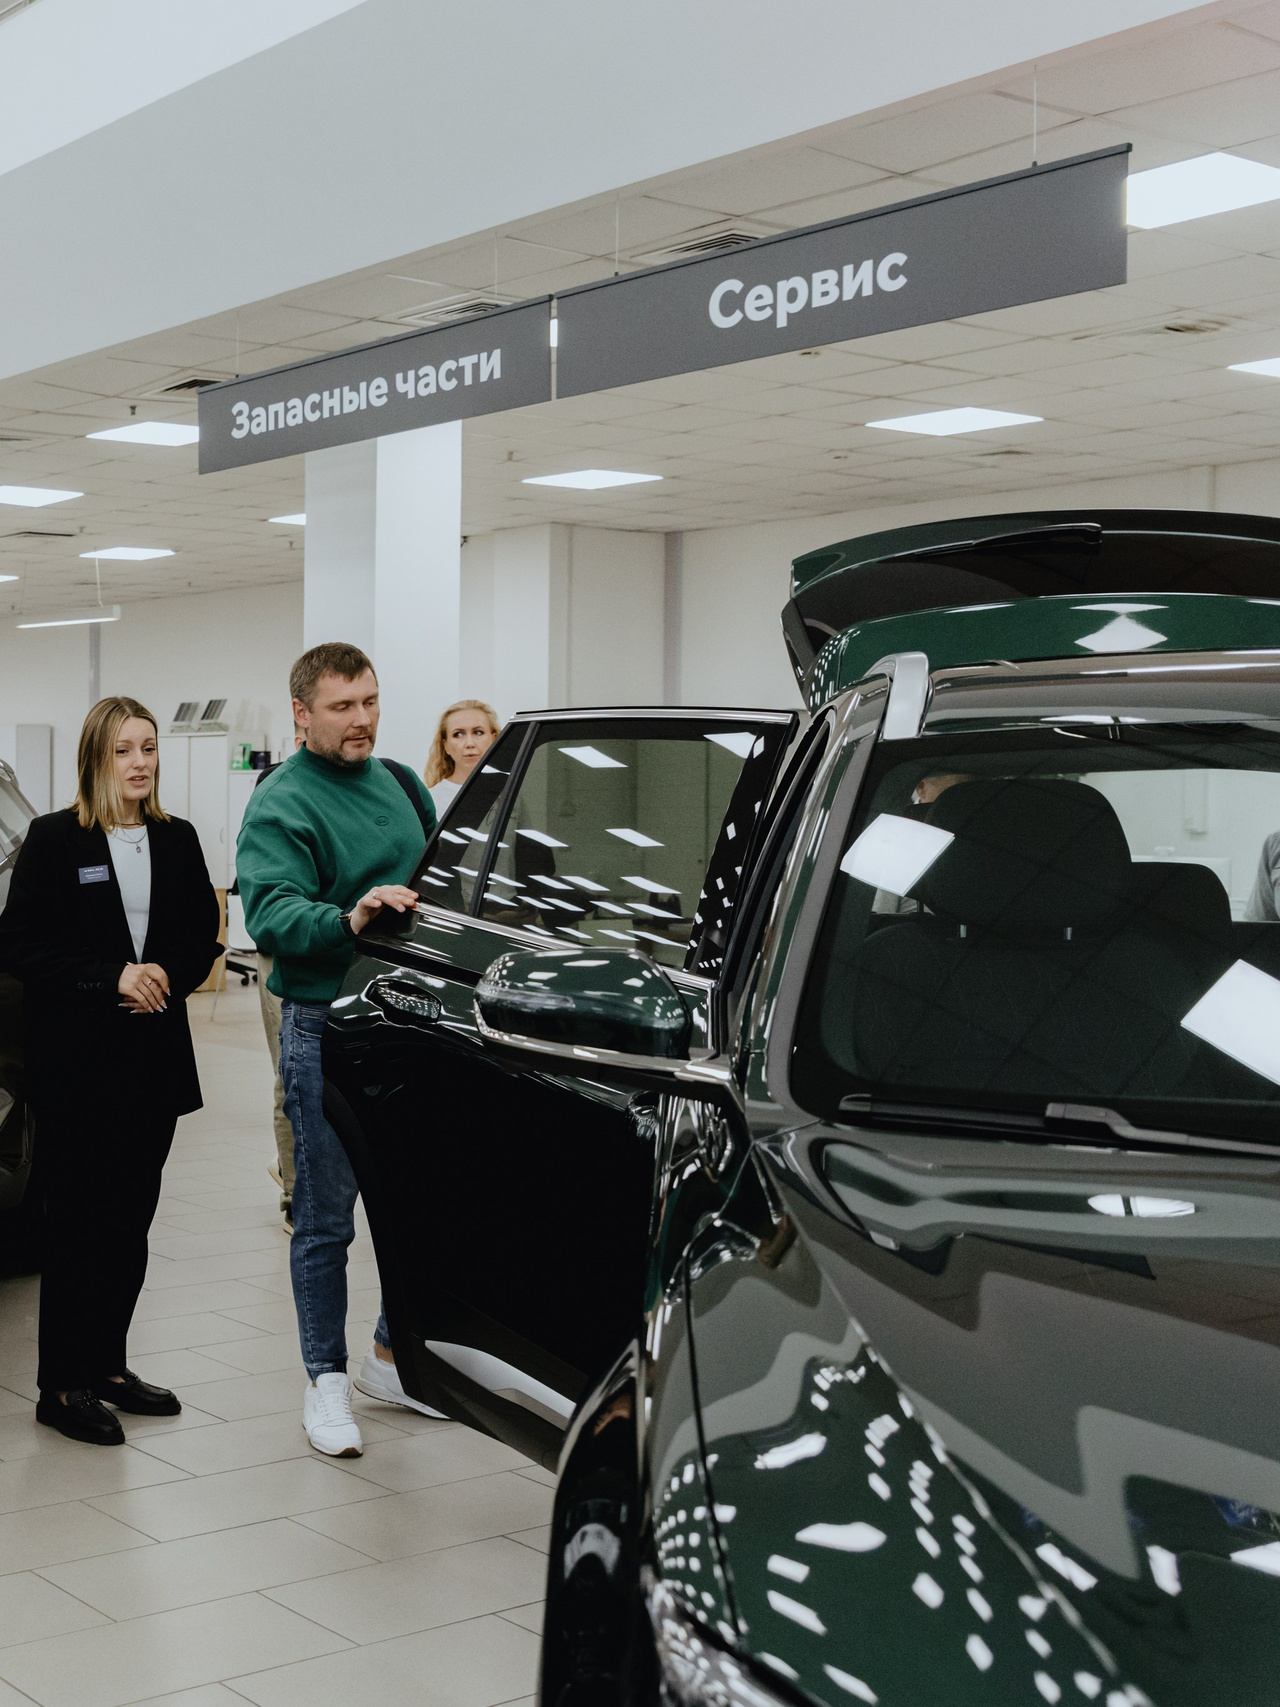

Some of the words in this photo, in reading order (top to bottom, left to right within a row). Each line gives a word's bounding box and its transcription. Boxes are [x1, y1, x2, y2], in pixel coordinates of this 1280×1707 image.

[708, 252, 908, 328] Сервис
[230, 377, 389, 439] Запасные
[395, 348, 501, 399] части
